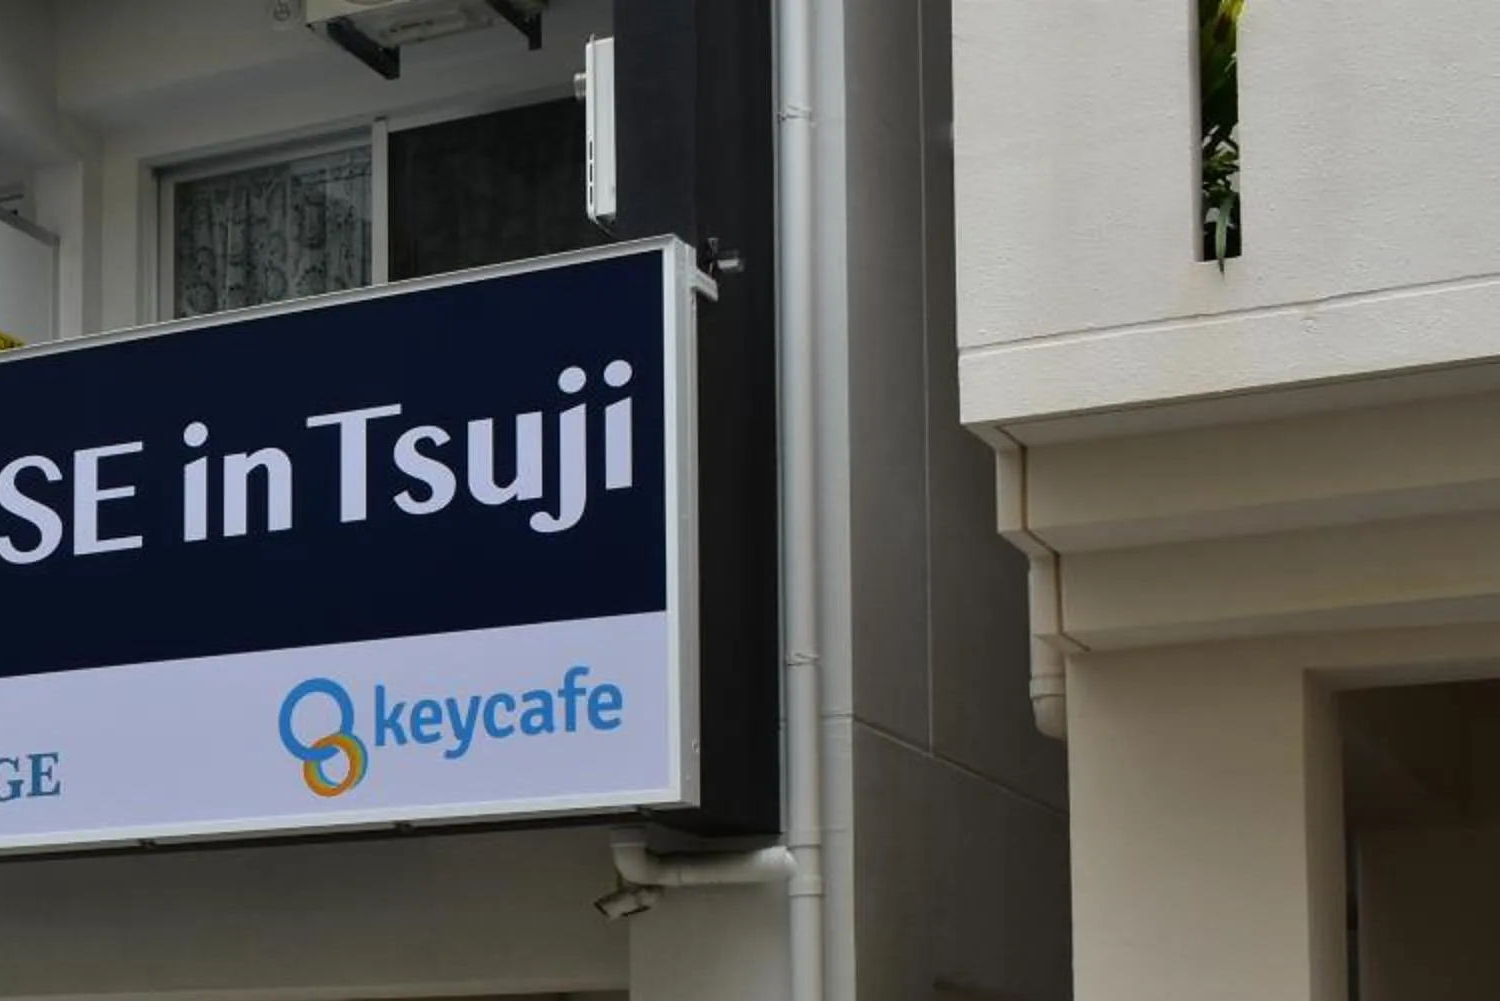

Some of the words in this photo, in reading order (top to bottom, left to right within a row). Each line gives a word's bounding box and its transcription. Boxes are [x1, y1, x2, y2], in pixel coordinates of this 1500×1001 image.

[183, 421, 293, 542] in
[306, 359, 633, 534] Tsuji
[373, 665, 623, 760] keycafe
